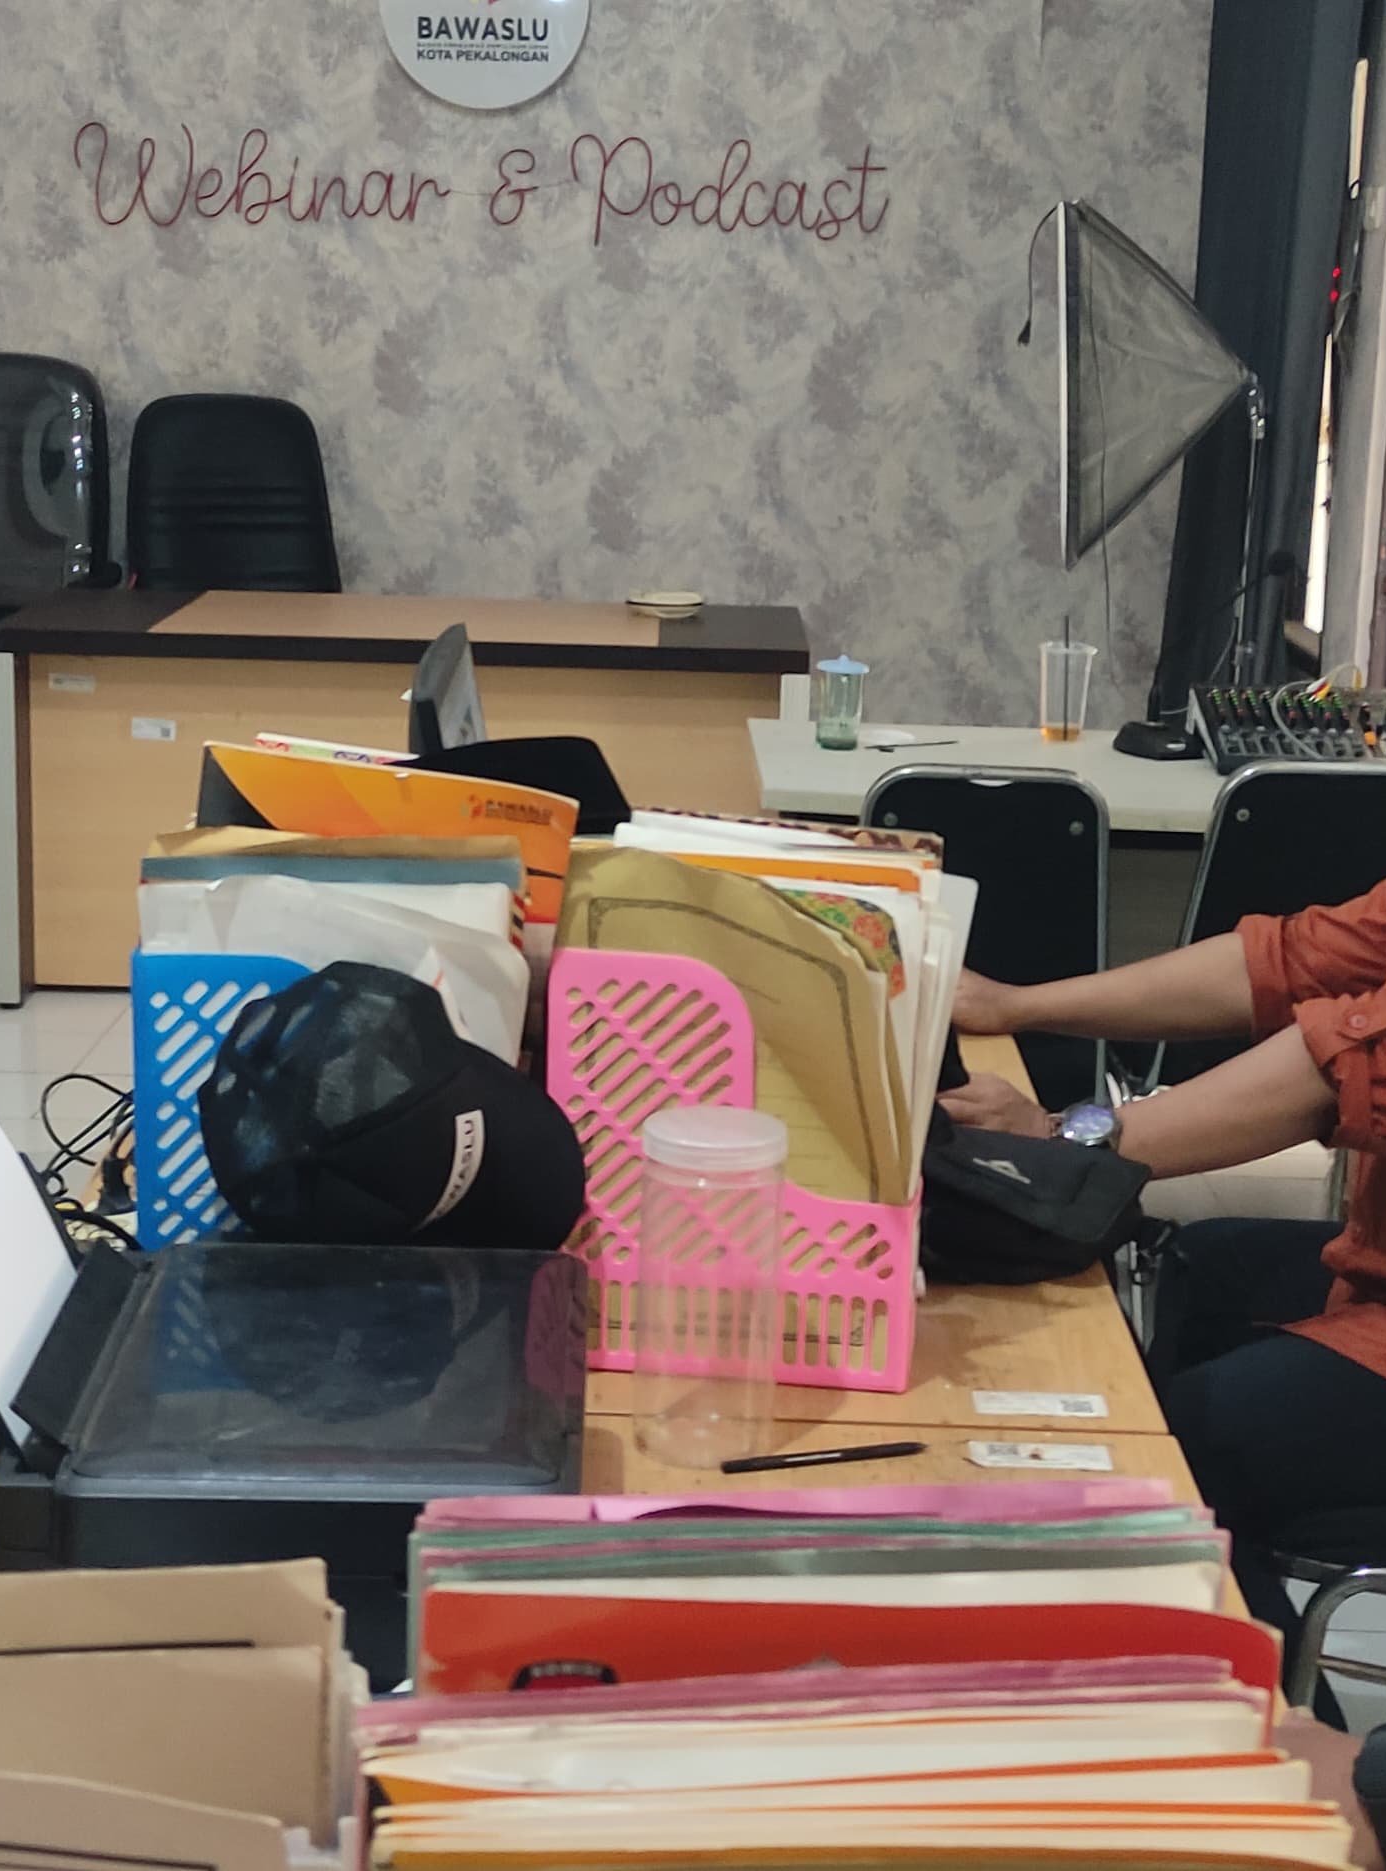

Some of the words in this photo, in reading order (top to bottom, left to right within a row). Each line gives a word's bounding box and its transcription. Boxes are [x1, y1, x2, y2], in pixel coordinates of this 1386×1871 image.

[417, 16, 549, 41] BAWASLU
[416, 49, 453, 61] KOTA
[456, 50, 550, 62] PEKALONGAN
[73, 121, 451, 227] Webinar
[489, 148, 539, 226] &
[570, 133, 890, 247] Podcast
